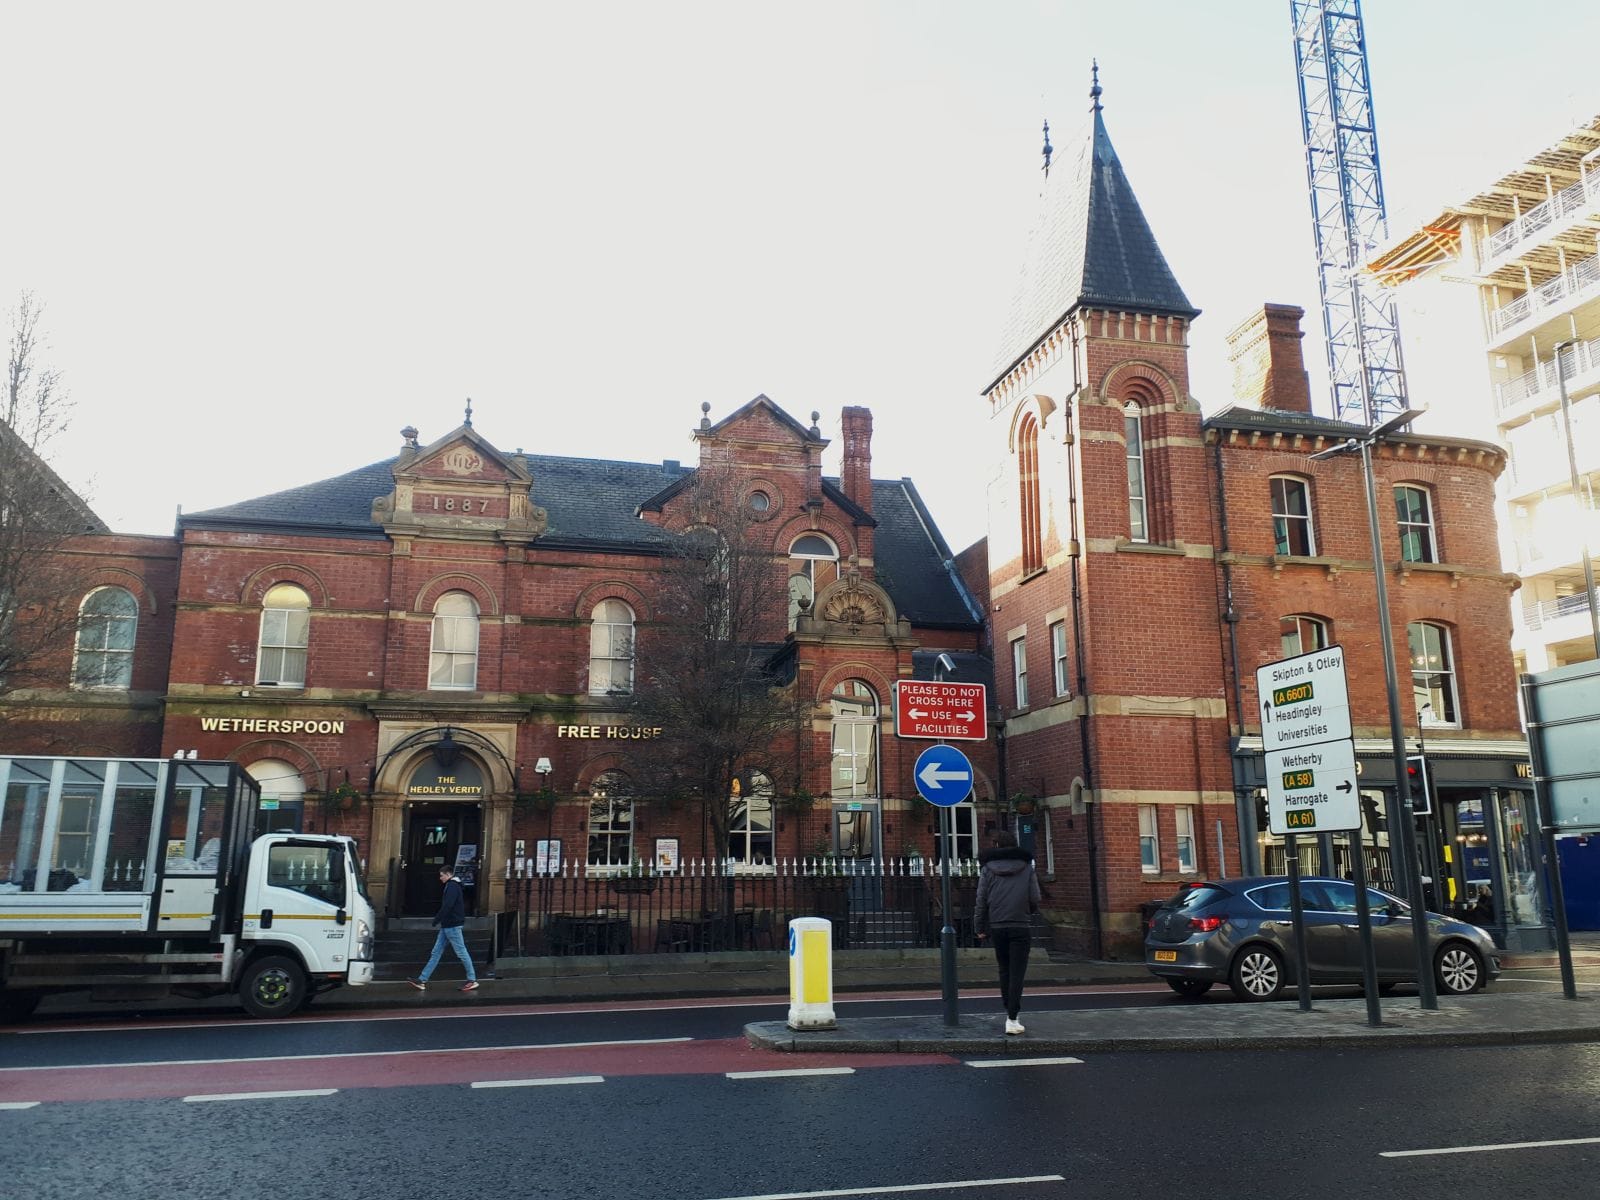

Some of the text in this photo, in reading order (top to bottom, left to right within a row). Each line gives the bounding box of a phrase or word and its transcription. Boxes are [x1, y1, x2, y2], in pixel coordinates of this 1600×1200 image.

[433, 496, 489, 512] 1887
[1273, 656, 1341, 682] Skipton & Otley
[901, 685, 981, 697] PLEASE DO NOT
[908, 696, 974, 707] CROSS HERE
[1275, 692, 1285, 705] (A
[931, 711, 952, 720] USE
[1276, 705, 1322, 722] Headingley
[201, 718, 345, 734] WETHERSPOON
[557, 725, 662, 739] FREE HOUSE
[915, 724, 969, 734] FACILITIES
[1278, 724, 1328, 742] Universities
[1282, 752, 1322, 767] Wetherby
[438, 776, 456, 784] THE
[1284, 772, 1313, 788] (A 58)
[410, 785, 482, 794] HEDLEY VERITY
[1285, 792, 1329, 806] Harrogate
[1287, 812, 1314, 826] (A 61)
